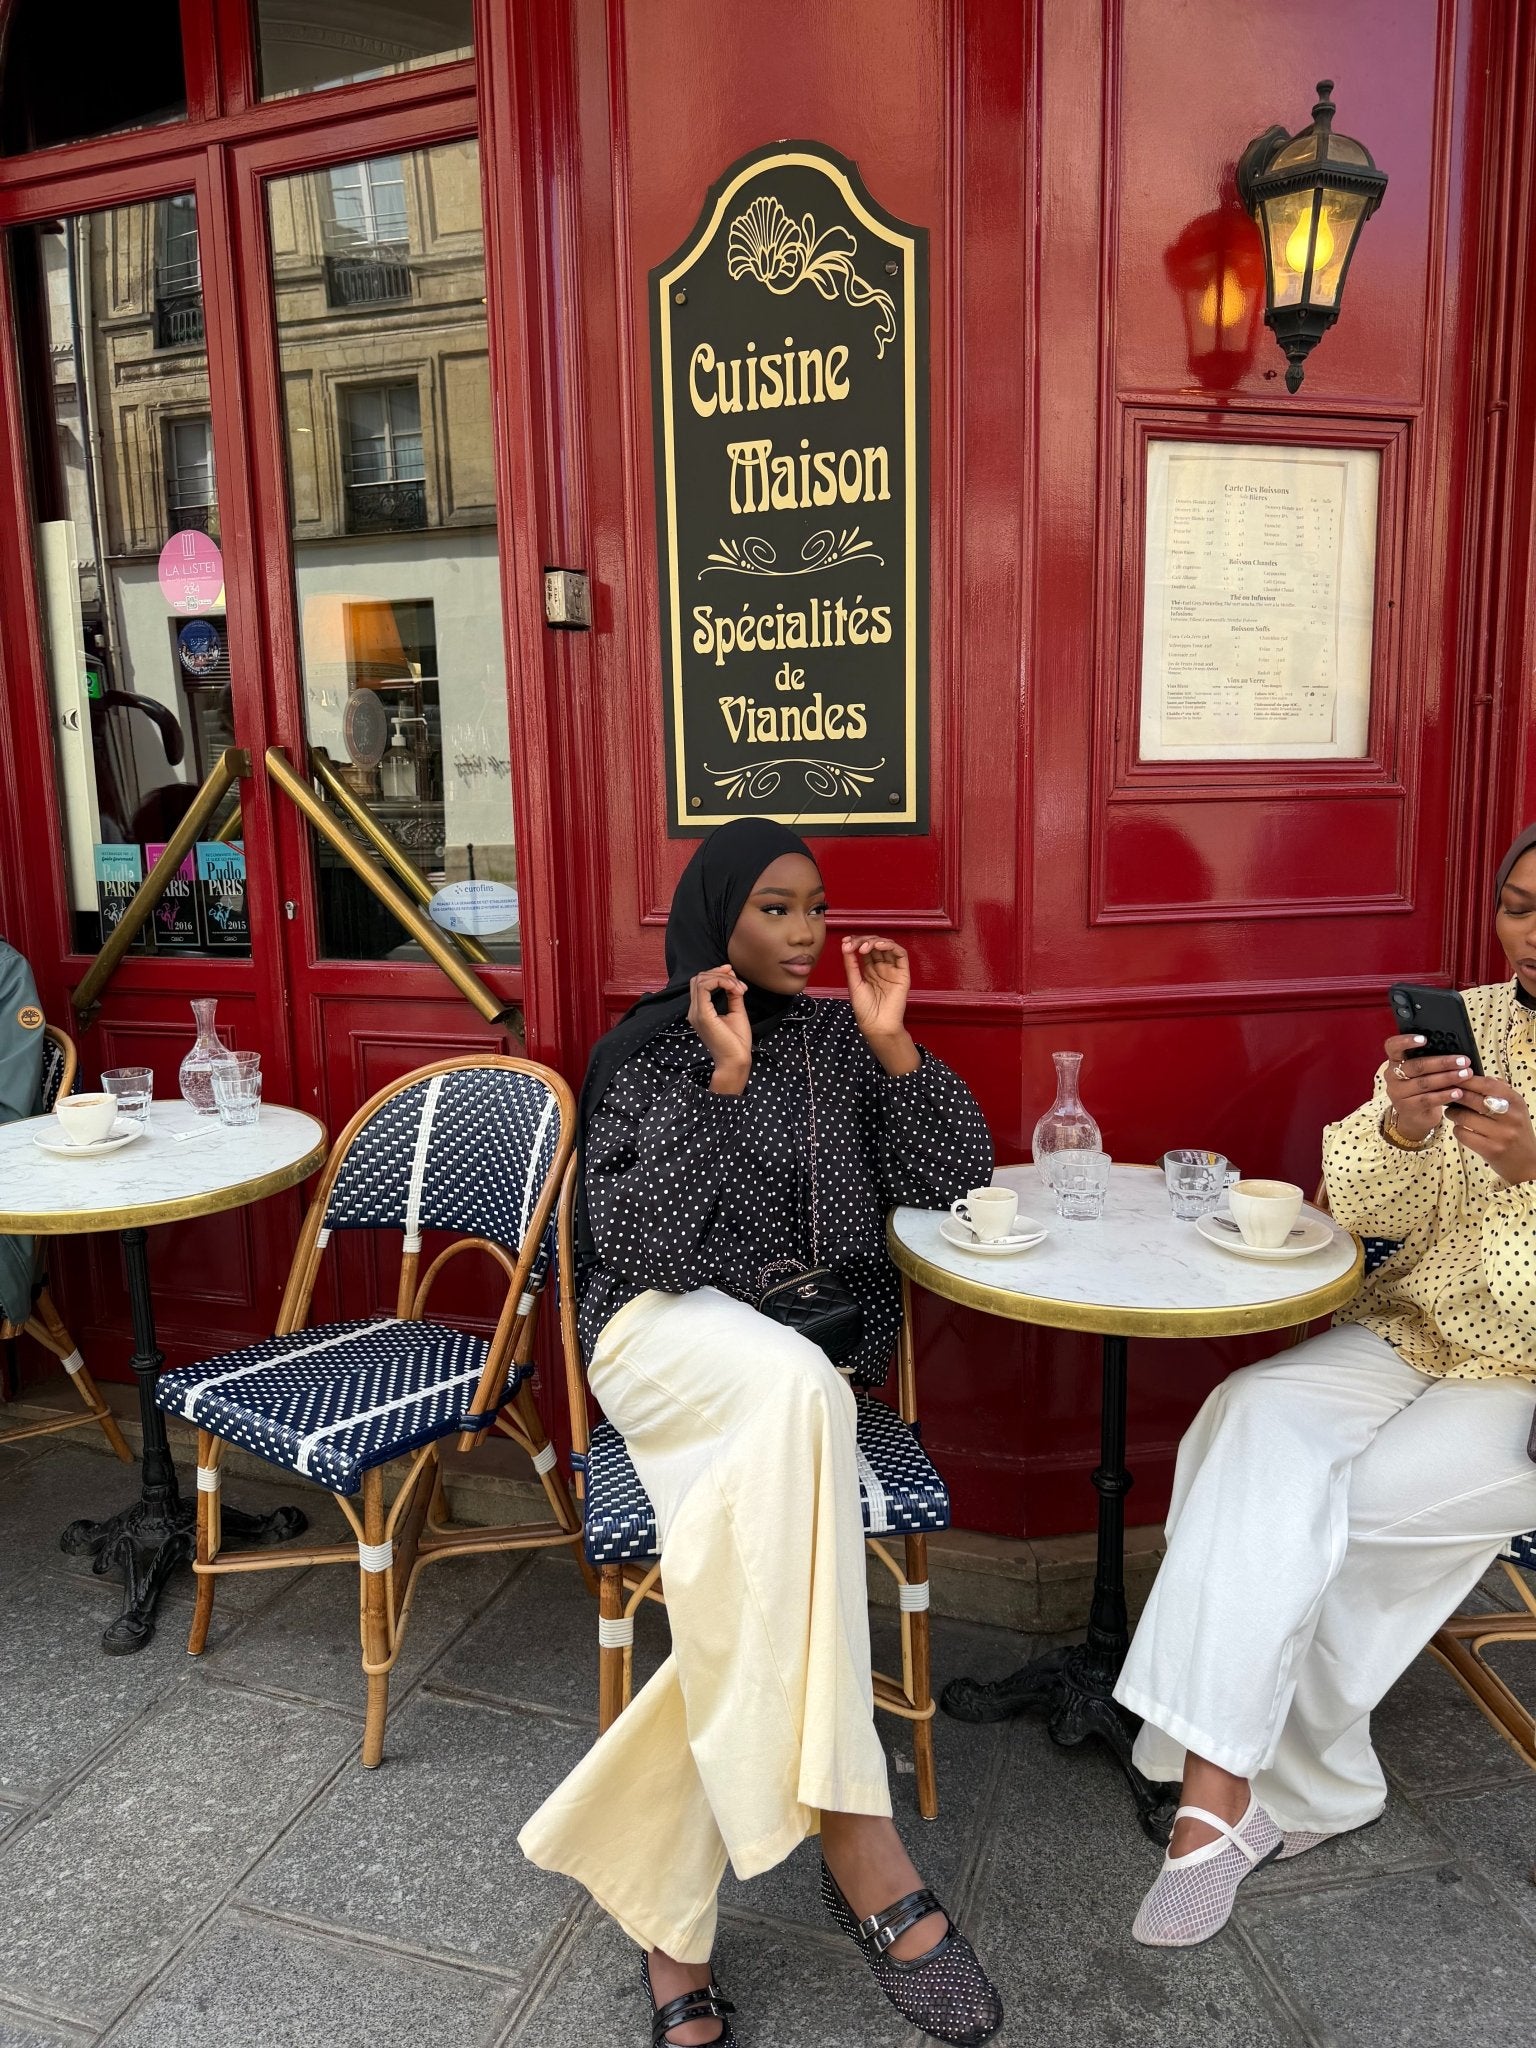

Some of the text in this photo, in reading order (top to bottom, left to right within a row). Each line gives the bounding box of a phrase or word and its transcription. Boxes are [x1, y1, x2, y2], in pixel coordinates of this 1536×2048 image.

[689, 336, 850, 417] Cuisine
[726, 438, 891, 515] Maison
[1224, 484, 1289, 494] Carte Des Boissons
[165, 565, 179, 576] LA
[183, 562, 211, 575] LISTE
[692, 594, 893, 666] Spécialités
[775, 662, 805, 691] de
[718, 692, 868, 743] Viandes
[103, 864, 134, 881] Pudlo
[206, 861, 242, 880] Pudlo
[104, 880, 136, 897] PARIS
[163, 879, 190, 897] ARIS
[208, 879, 244, 896] PARIS
[464, 884, 494, 893] eurofins
[175, 921, 193, 931] 2016
[228, 920, 246, 930] 2015
